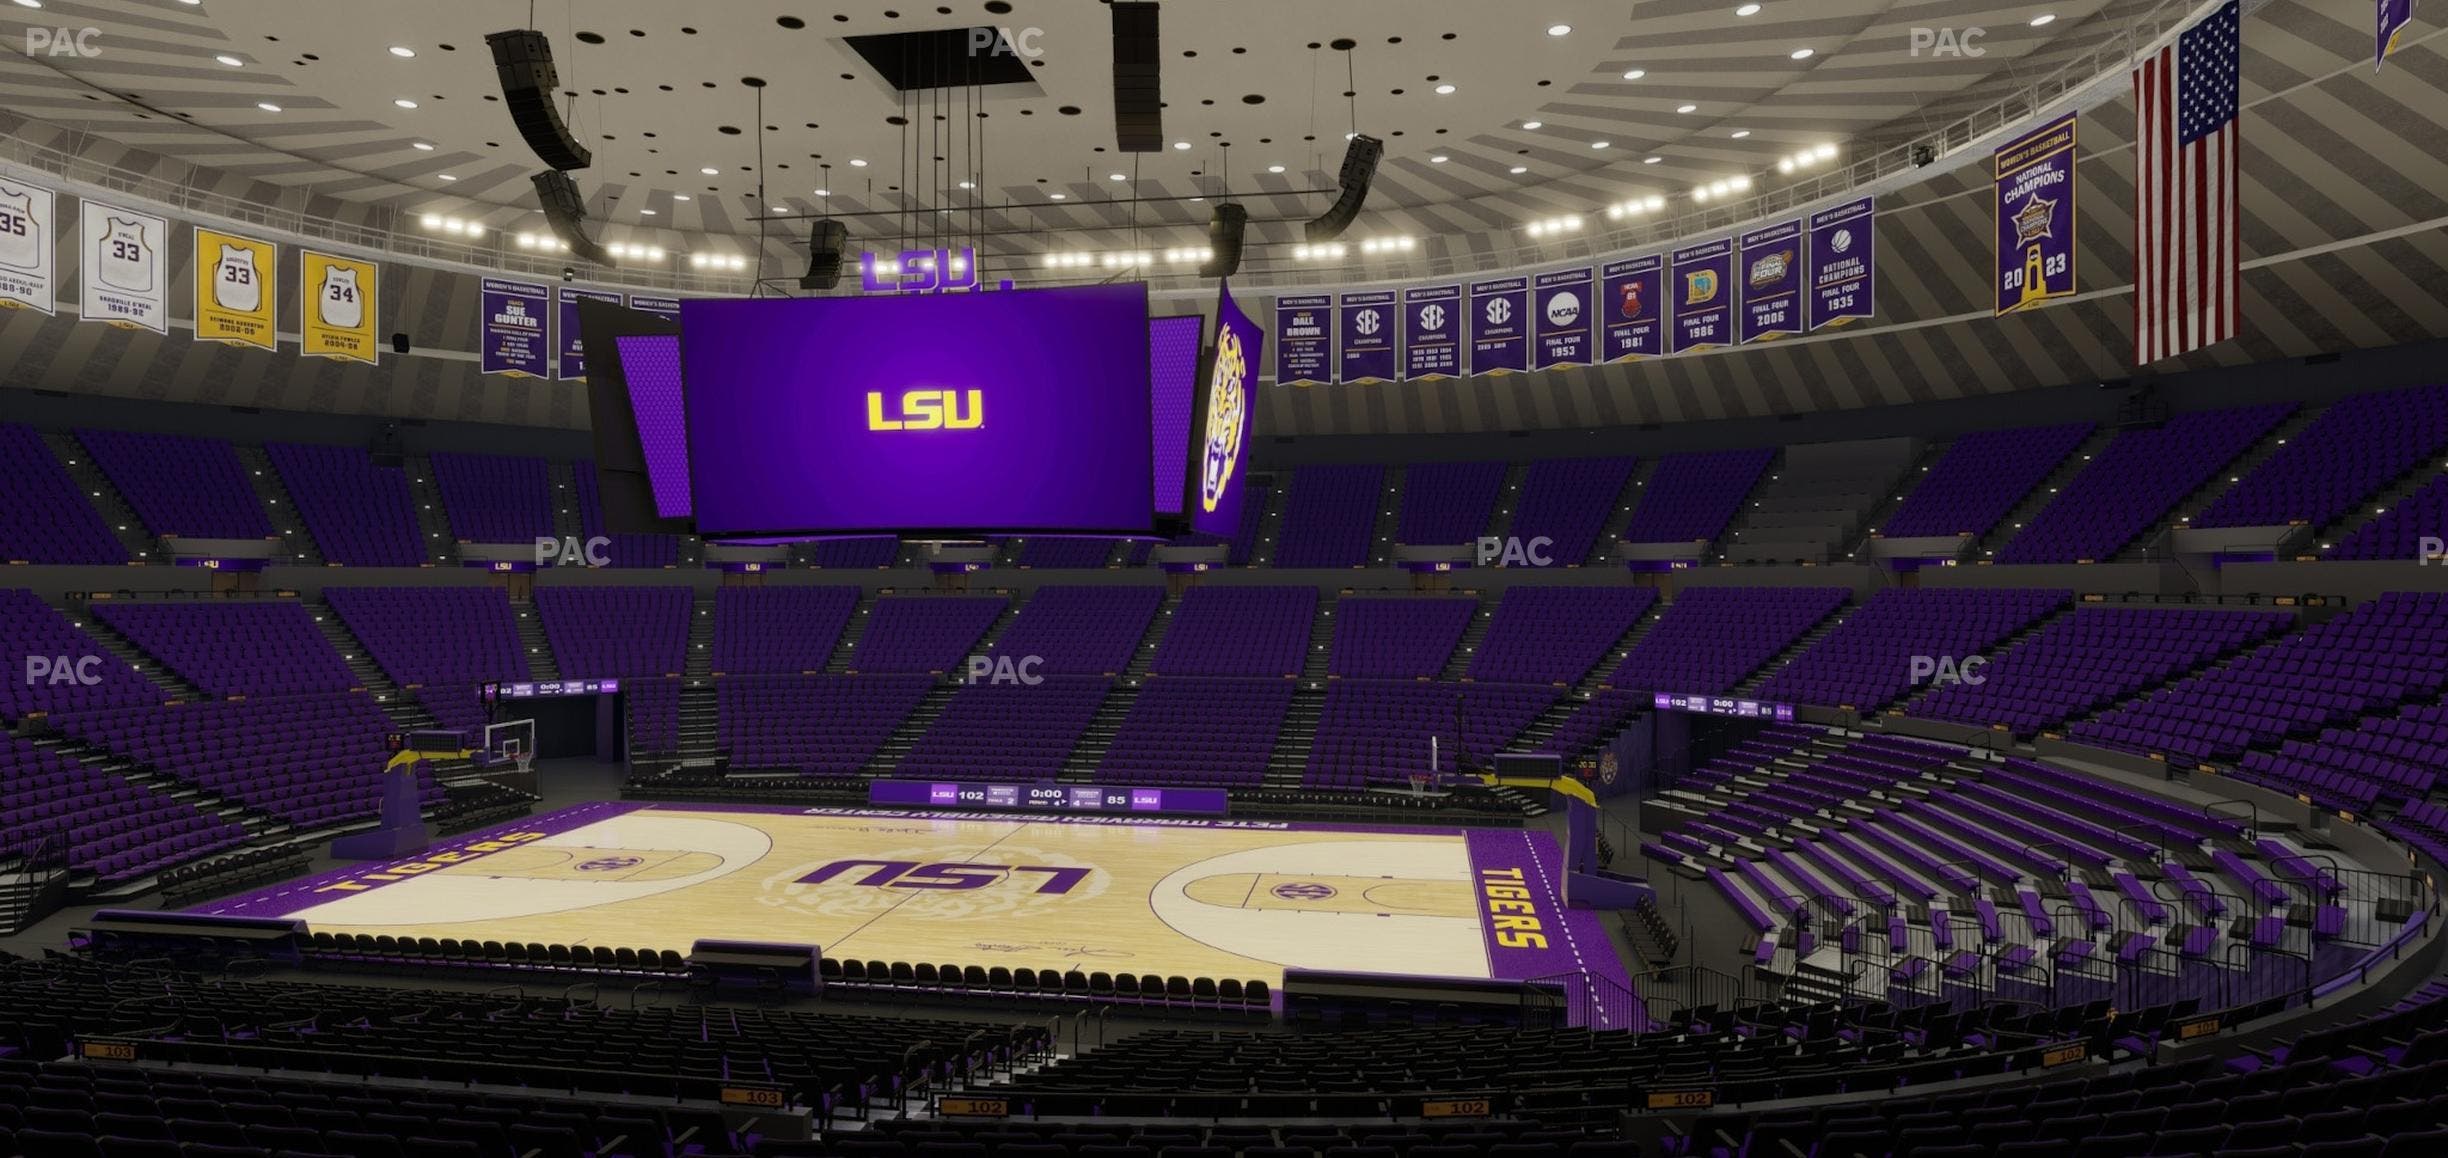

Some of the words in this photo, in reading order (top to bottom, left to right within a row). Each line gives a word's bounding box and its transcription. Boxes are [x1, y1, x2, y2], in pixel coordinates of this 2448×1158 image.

[2000, 149, 2029, 169] WOMEN'S
[2030, 131, 2070, 154] BASKETBALL
[2016, 162, 2052, 185] NATIONAL
[2004, 170, 2065, 204] CHAMPIONS
[1816, 214, 1834, 224] MEN'S
[1834, 204, 1866, 219] BASKETBALL
[1747, 234, 1763, 243] MEN'S
[1763, 225, 1794, 239] BASKETBALL
[113, 240, 140, 262] 33
[1678, 250, 1695, 259] MEN'S
[1695, 244, 1725, 255] BASKETBALL
[861, 247, 978, 292] LSU
[1625, 259, 1655, 270] BASKETBALL
[1823, 257, 1861, 274] NATIONAL
[225, 265, 250, 285] 33
[1755, 266, 1782, 280] FOUR
[1818, 265, 1865, 284] CHAMPIONS
[2004, 268, 2023, 290] 20
[2045, 253, 2066, 277] 23
[513, 285, 545, 295] BASKETBALL
[1623, 282, 1639, 290] NCAA
[1821, 289, 1840, 298] FINAL
[1841, 283, 1860, 294] FOUR
[330, 284, 353, 303] 34
[1627, 292, 1636, 300] 81
[1752, 304, 1770, 314] FINAL
[1771, 299, 1789, 309] FOUR
[1828, 296, 1853, 311] 1935
[506, 305, 526, 316] SUE
[1486, 297, 1511, 324] SEC
[1551, 307, 1578, 318] NCAA
[495, 313, 537, 327] GUNTER
[1293, 317, 1314, 326] DALE
[1355, 309, 1380, 335] SEC
[1420, 304, 1445, 331] SEC
[1683, 319, 1701, 327] FINAL
[1702, 314, 1719, 323] FOUR
[1757, 311, 1784, 327] 2006
[1287, 326, 1320, 337] BROWN
[1614, 329, 1631, 338] FINAL
[1633, 326, 1650, 334] FOUR
[1689, 325, 1713, 338] 1986
[1546, 338, 1562, 346] FINAL
[1564, 336, 1581, 344] FOUR
[1621, 337, 1642, 349] 1981
[1552, 346, 1575, 357] 1953
[867, 389, 982, 431] LSU
[495, 562, 512, 570] LSU
[745, 563, 760, 571] LSU
[1435, 563, 1450, 571] LSU
[1713, 699, 1733, 707] 0:00
[959, 791, 984, 800] 102
[1031, 789, 1062, 798] 0:00
[1107, 796, 1126, 804] 85
[803, 808, 909, 818] CENTER
[910, 811, 1059, 822] ASSEMBLY
[1061, 815, 1209, 827] MARAVICH
[1215, 820, 1288, 829] PETE
[313, 832, 546, 893] TIGERS
[792, 859, 1092, 894] LSU
[1482, 867, 1548, 949] TIGERS
[104, 1047, 131, 1057] 103
[2060, 1048, 2082, 1061] 102
[747, 1091, 778, 1104] 103
[1674, 1094, 1706, 1105] 102
[967, 1103, 1001, 1113] 102
[1451, 1102, 1484, 1114] 102
